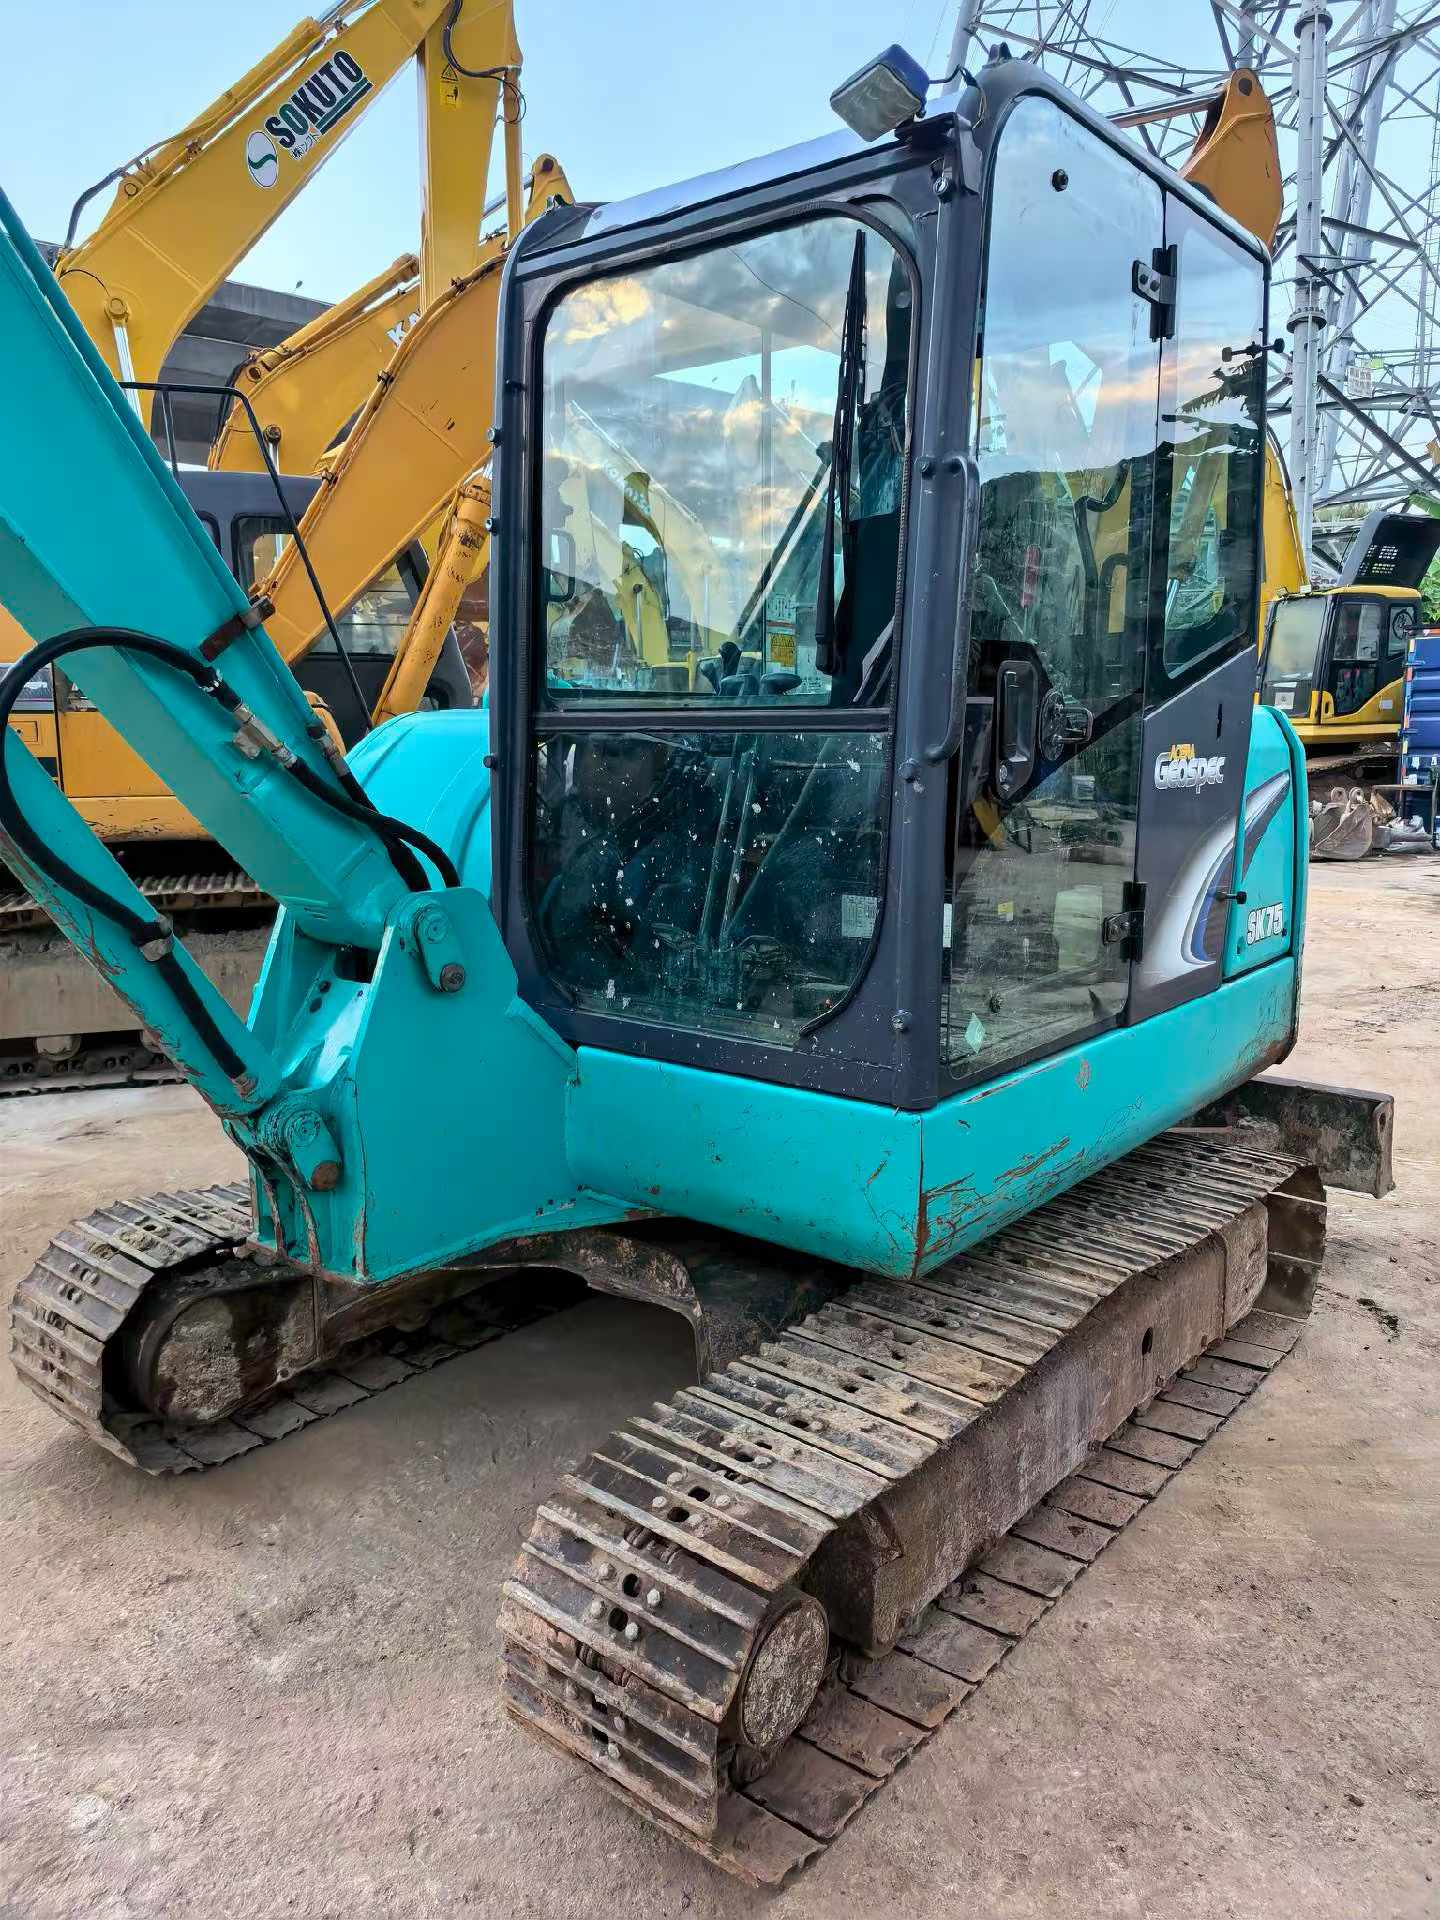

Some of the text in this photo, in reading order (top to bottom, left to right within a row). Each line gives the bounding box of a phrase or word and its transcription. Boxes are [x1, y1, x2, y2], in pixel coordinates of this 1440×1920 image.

[264, 50, 363, 149] SOKUTO
[1154, 751, 1226, 795] Geospec
[1247, 902, 1283, 945] SK75
